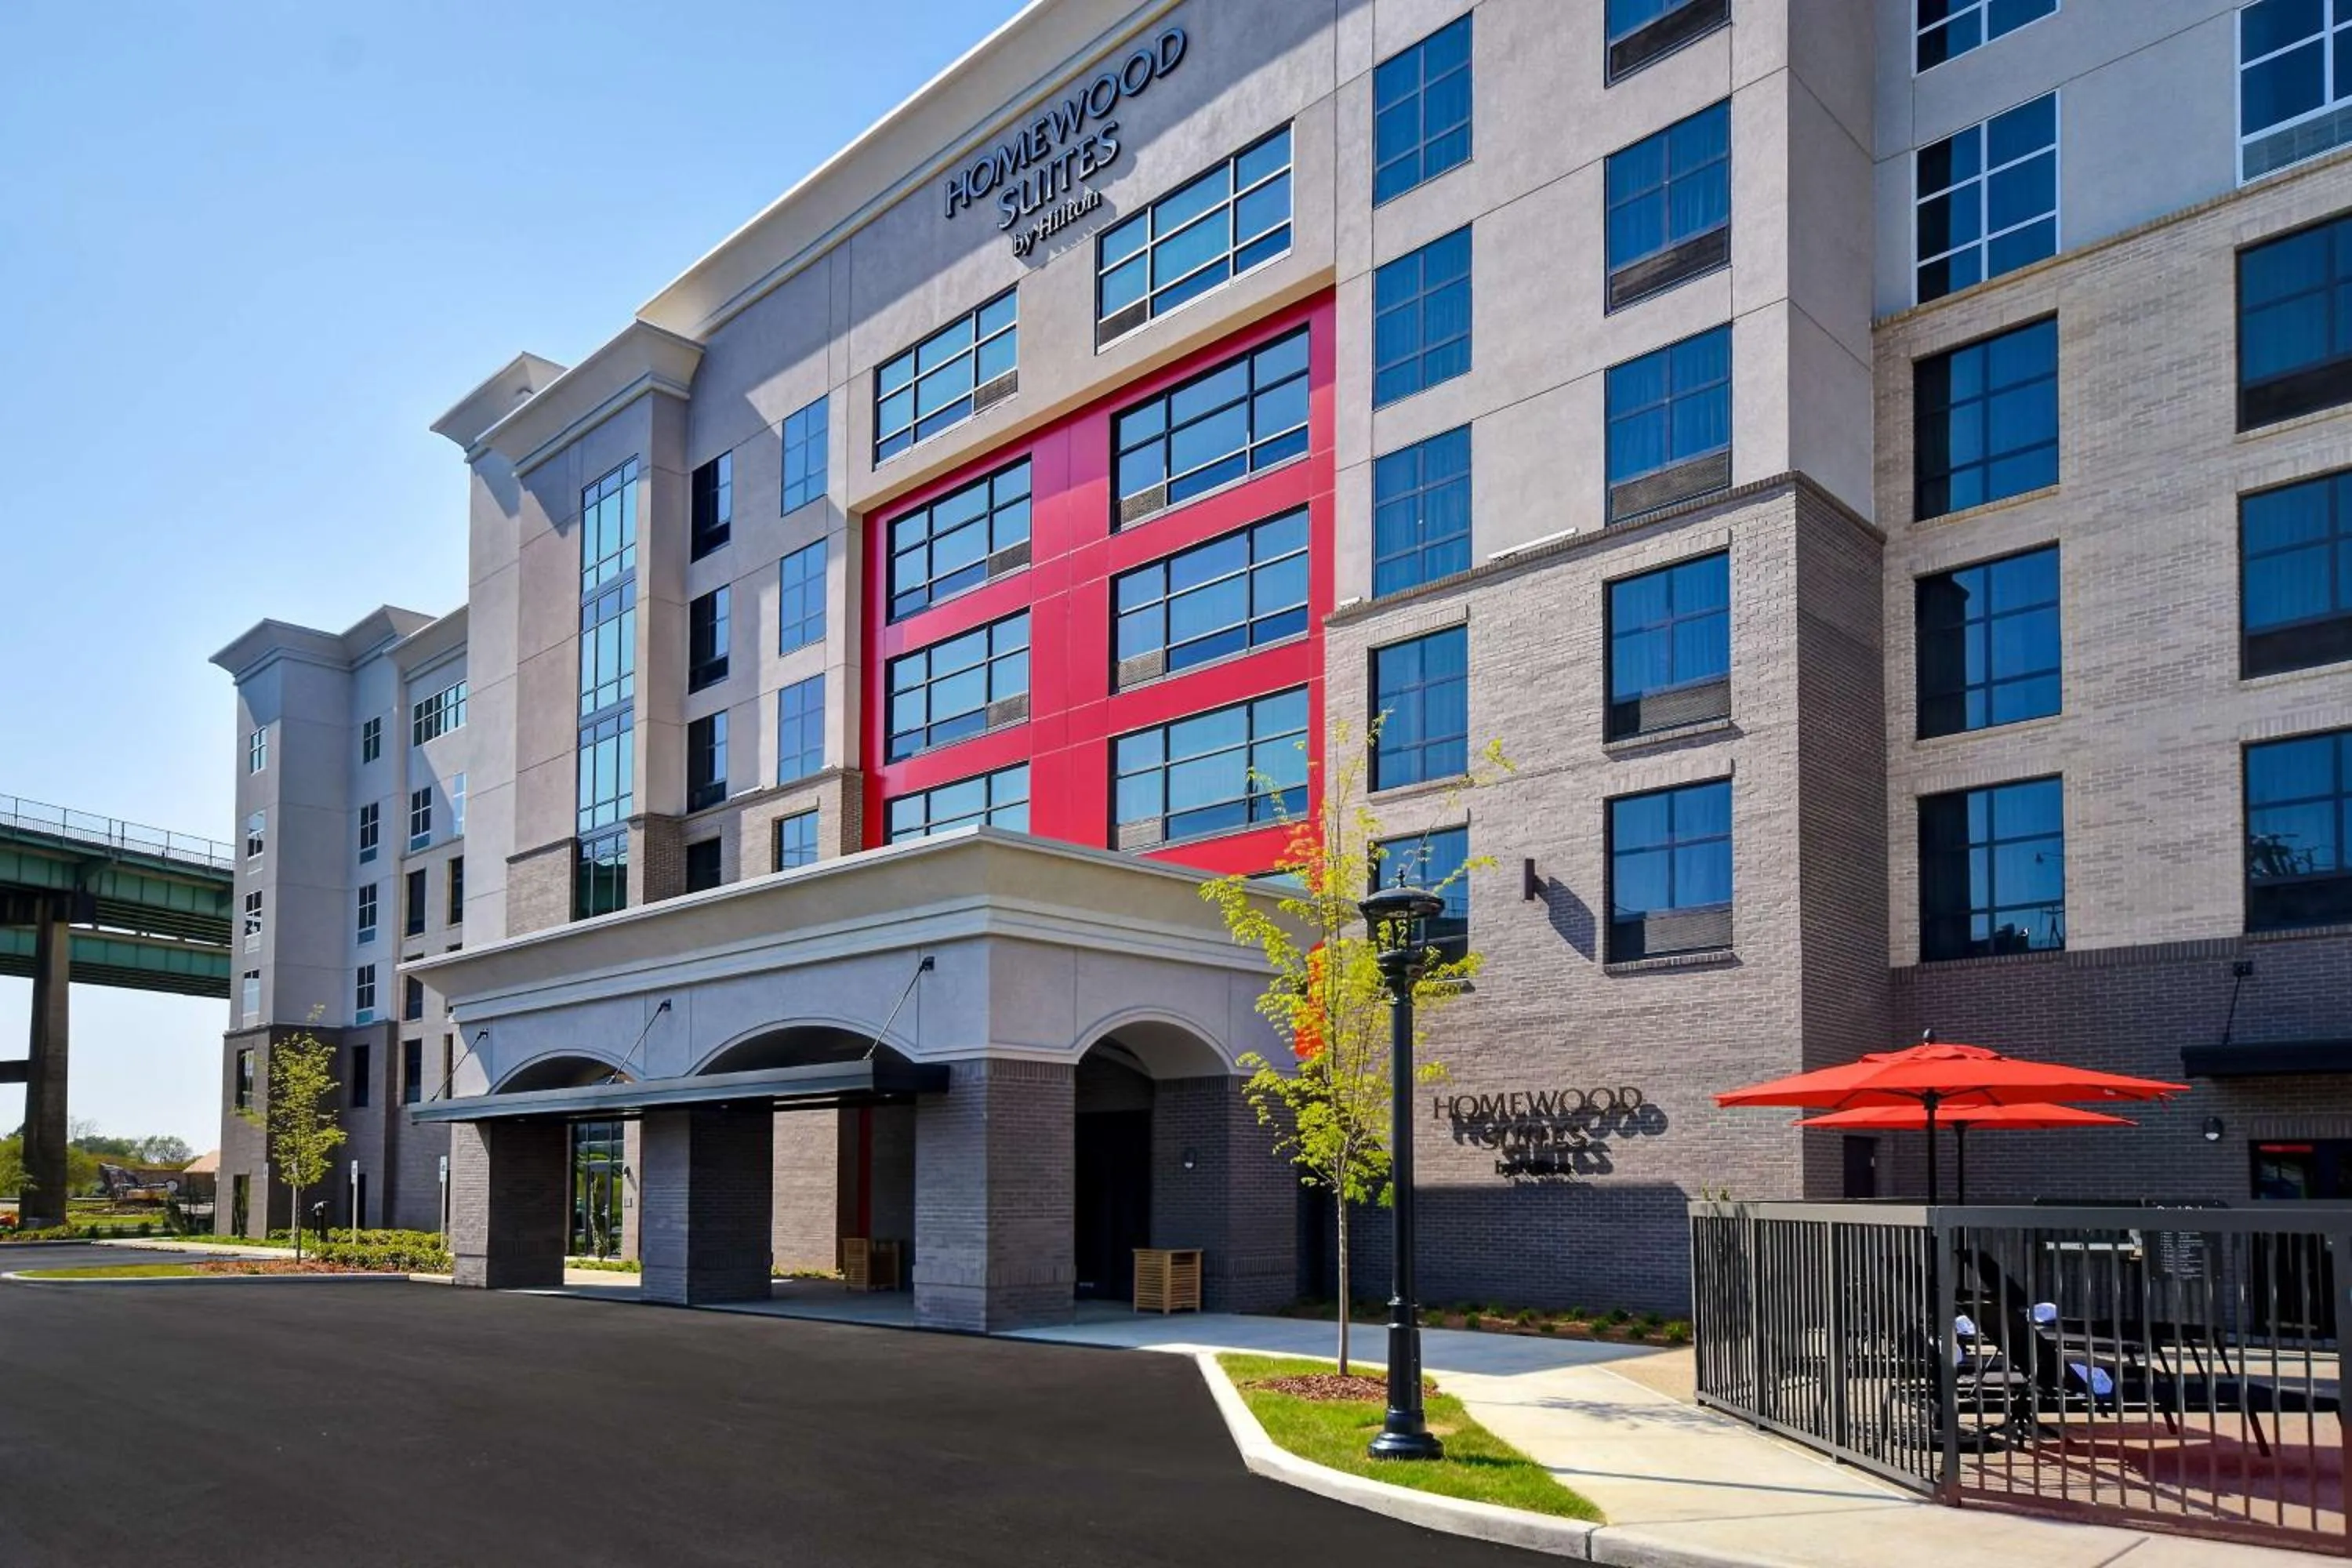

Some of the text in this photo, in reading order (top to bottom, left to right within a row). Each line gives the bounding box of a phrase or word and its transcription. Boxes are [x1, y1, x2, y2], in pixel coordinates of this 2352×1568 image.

[944, 27, 1188, 219] HOMEWOOD
[996, 121, 1122, 231] SUITES
[1012, 189, 1103, 257] by Hilton
[1433, 1086, 1643, 1120] HOMEWOOD
